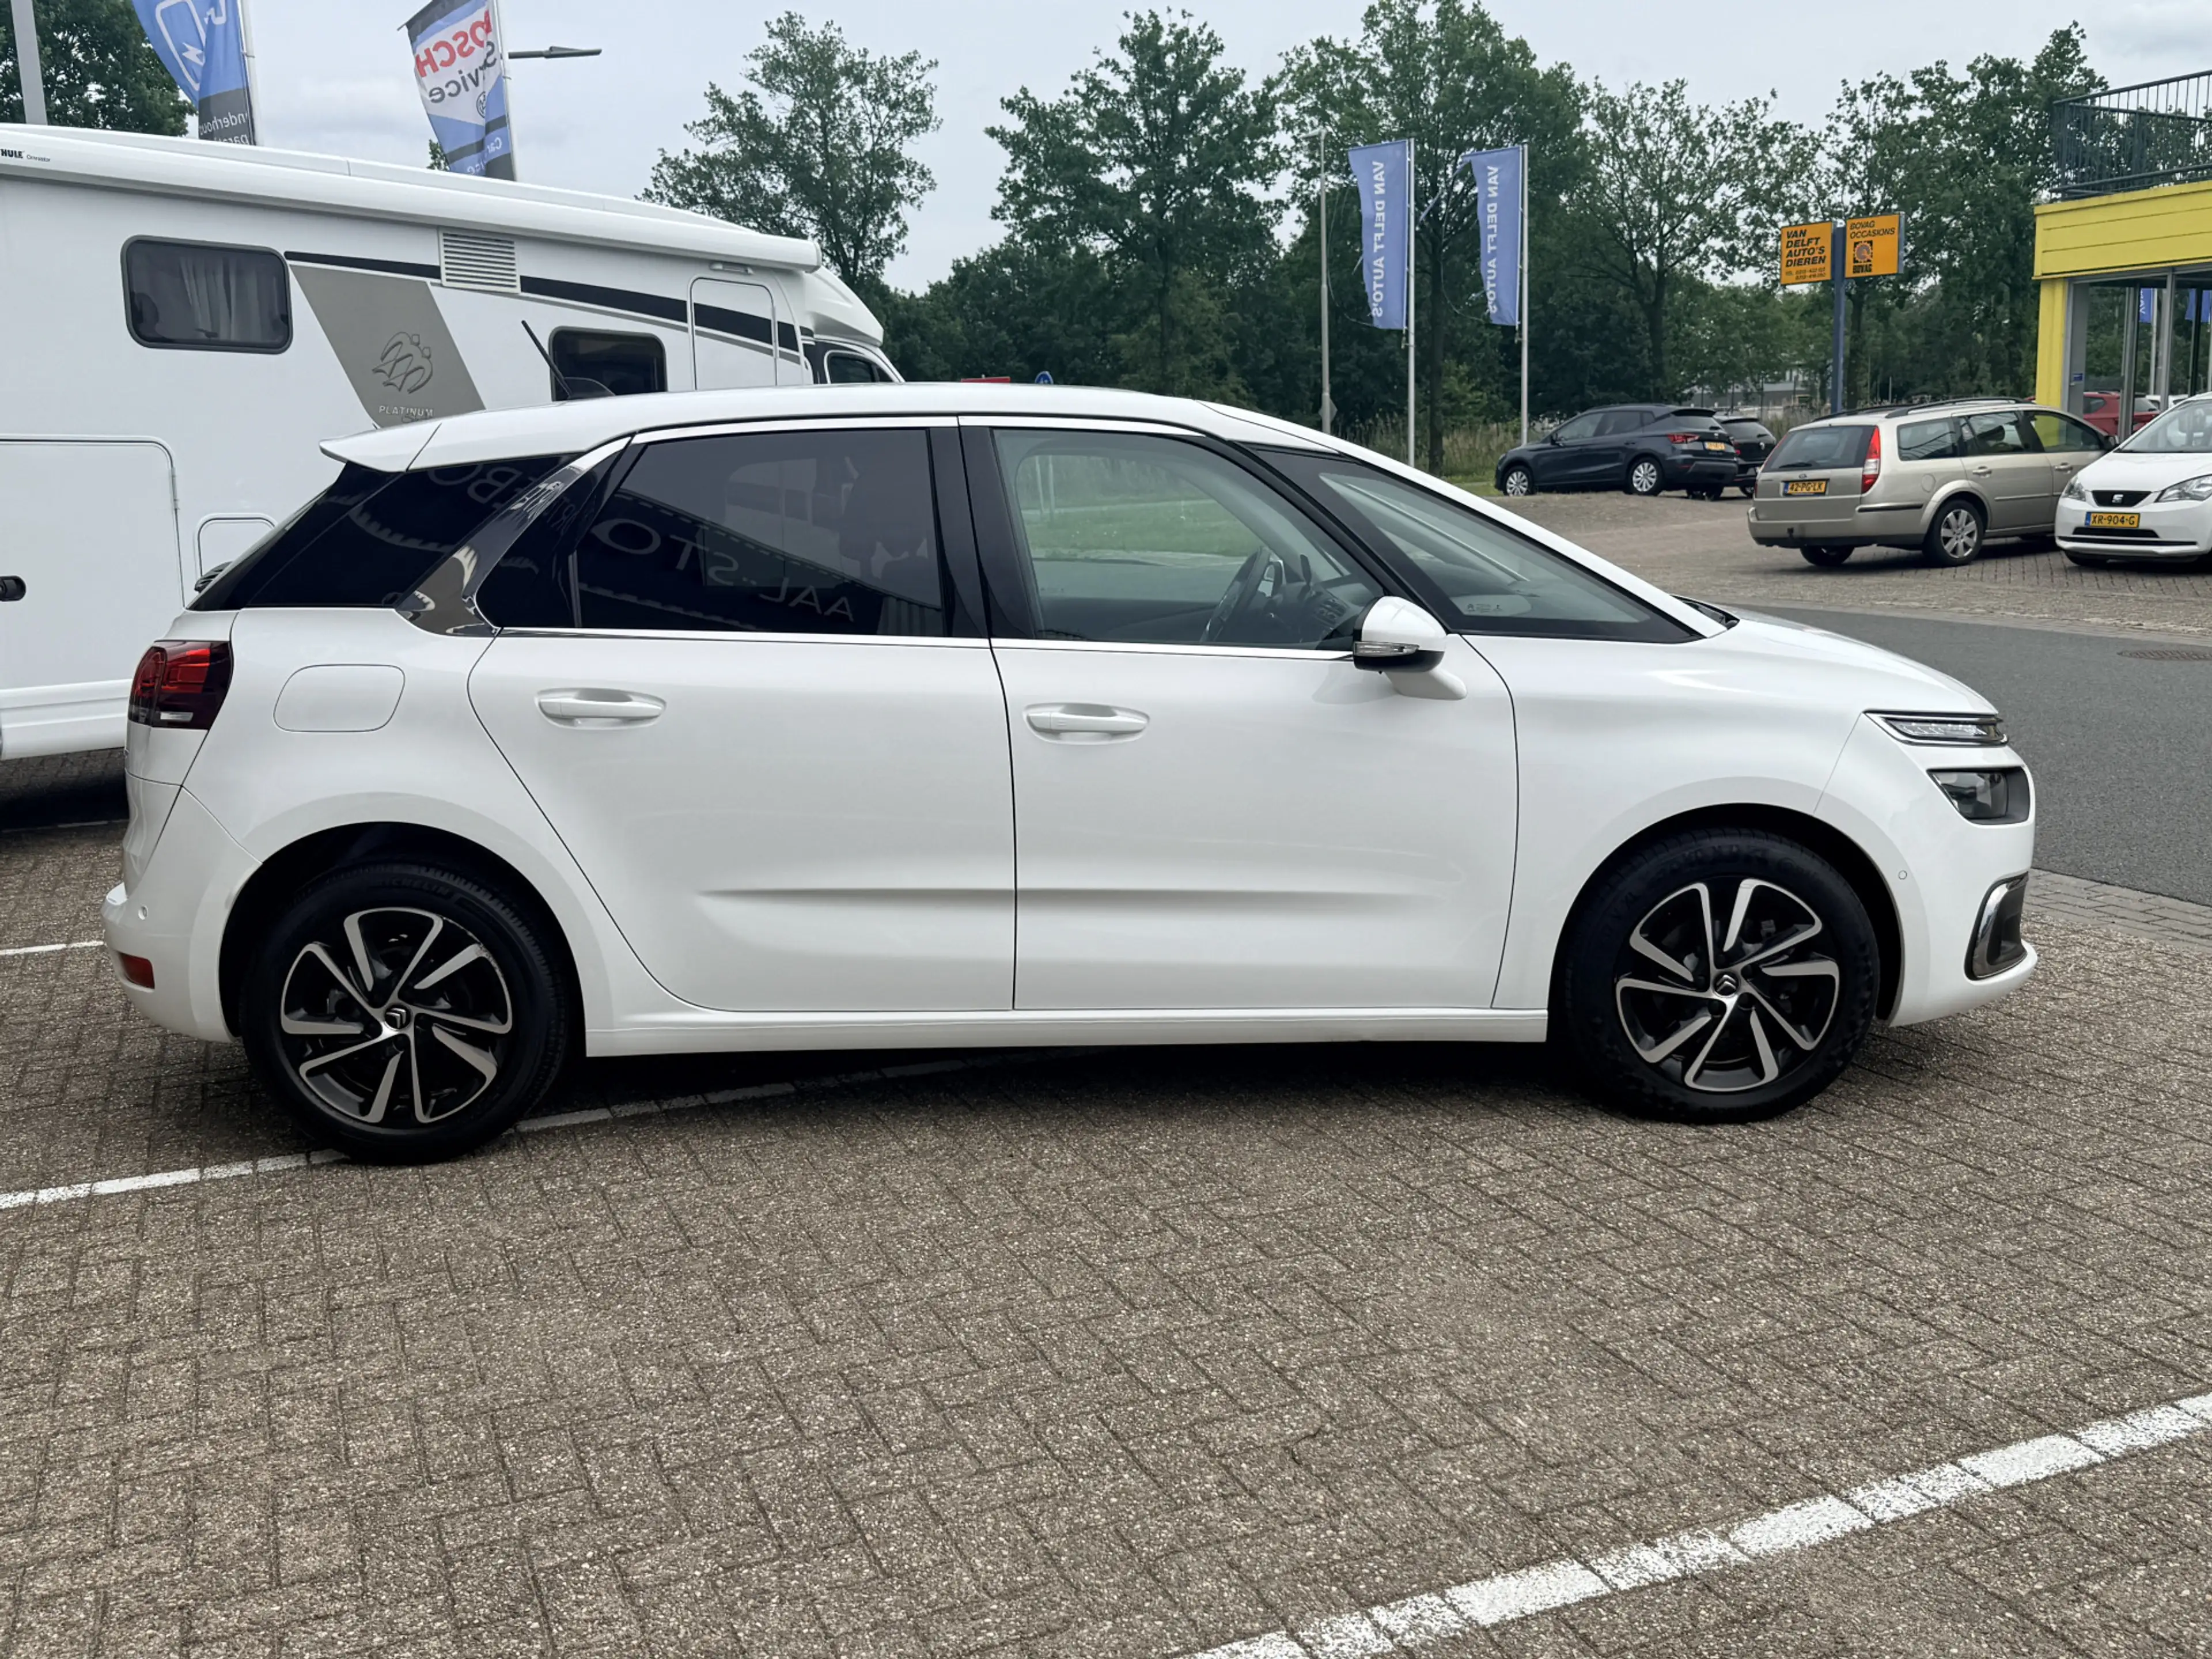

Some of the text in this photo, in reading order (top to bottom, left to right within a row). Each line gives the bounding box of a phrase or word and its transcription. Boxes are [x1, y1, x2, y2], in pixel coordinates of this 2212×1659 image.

[0, 149, 23, 159] HULE
[1786, 229, 1807, 239] VAN
[1850, 227, 1895, 239] OCCASIONS
[1786, 237, 1821, 249] DELFT
[1786, 245, 1825, 259] AUTO'S
[1786, 255, 1827, 268] DIEREN
[379, 405, 434, 417] PLATINUM
[1790, 482, 1823, 491] 42-PG-LK
[2092, 514, 2135, 525] XR-904-G
